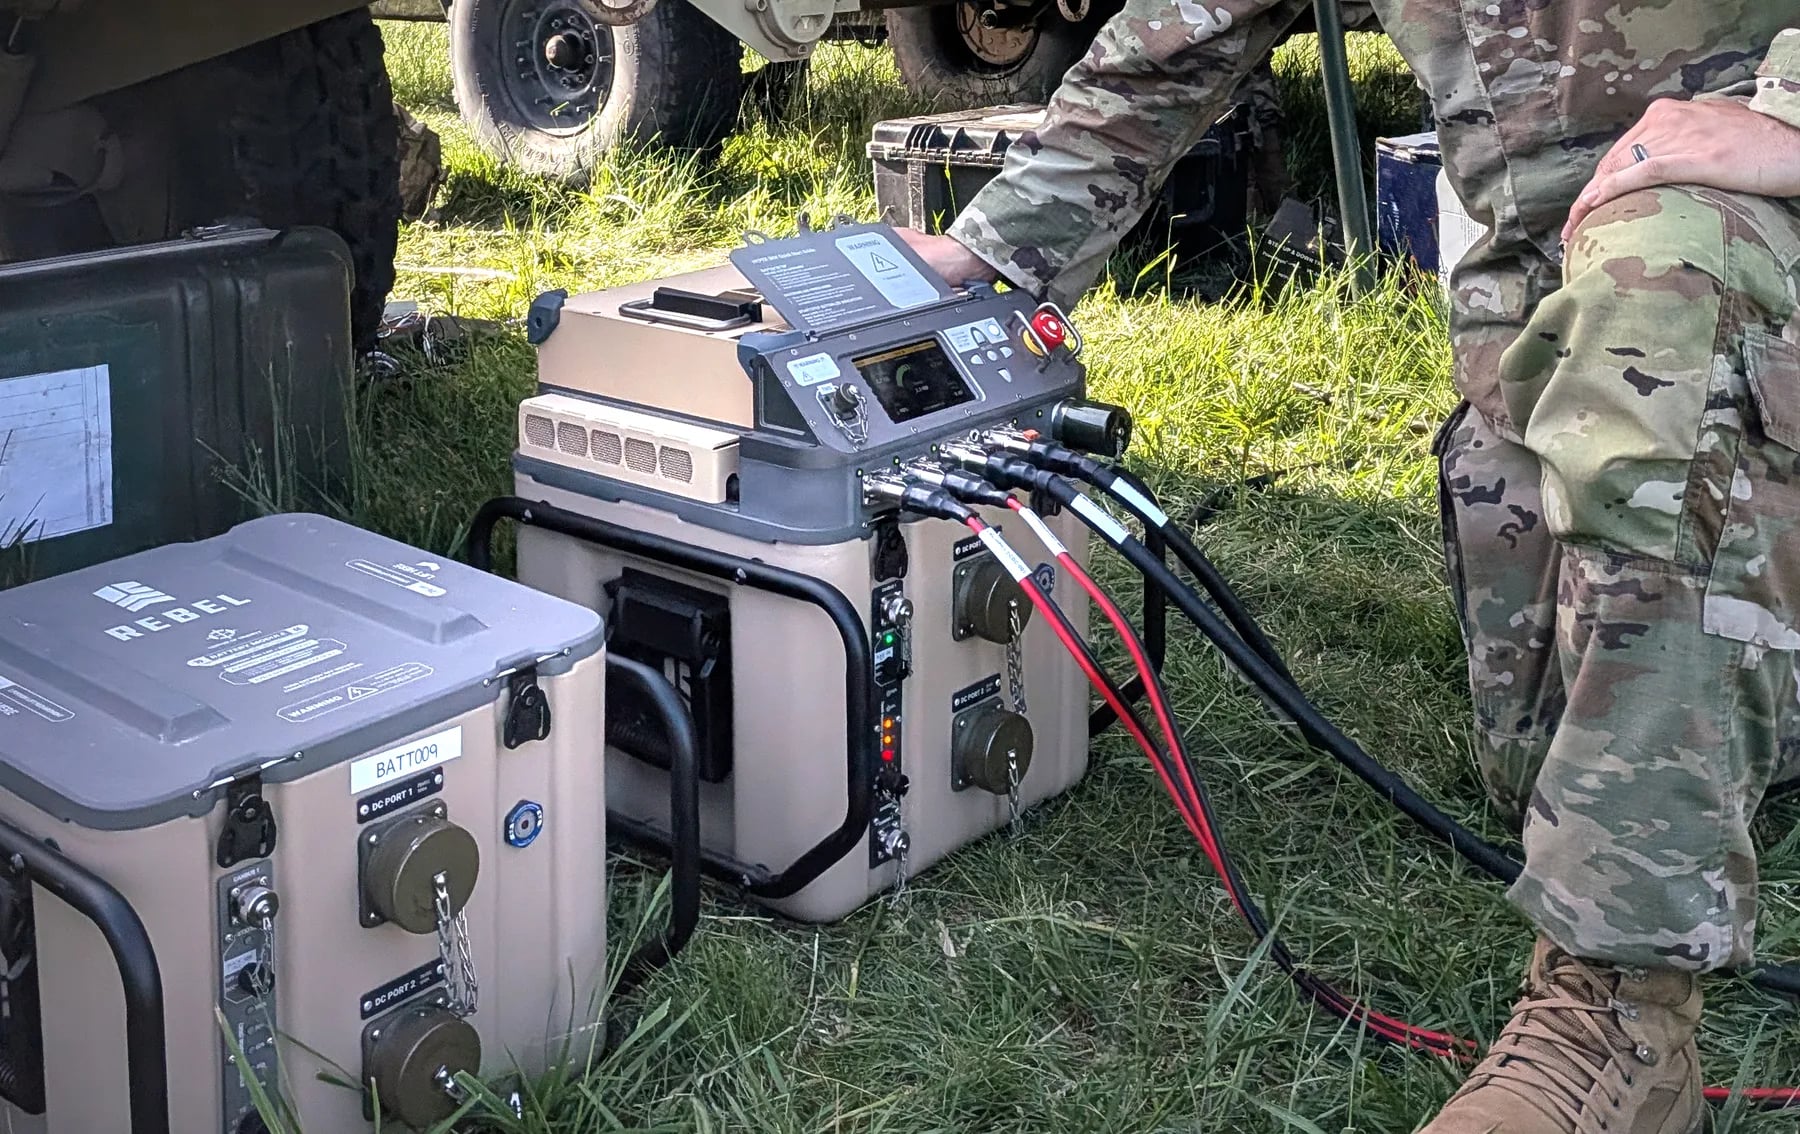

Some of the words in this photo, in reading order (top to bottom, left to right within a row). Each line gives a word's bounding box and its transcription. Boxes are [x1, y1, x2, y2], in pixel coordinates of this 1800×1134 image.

[104, 594, 252, 641] REBEL
[210, 643, 250, 660] BATTERY
[288, 695, 343, 718] WARNING
[968, 690, 981, 701] PORT
[376, 743, 438, 779] BATT009
[372, 800, 384, 812] DC
[385, 790, 407, 807] PORT
[374, 995, 387, 1007] DC
[387, 983, 410, 1000] PORT
[410, 979, 417, 990] 2
